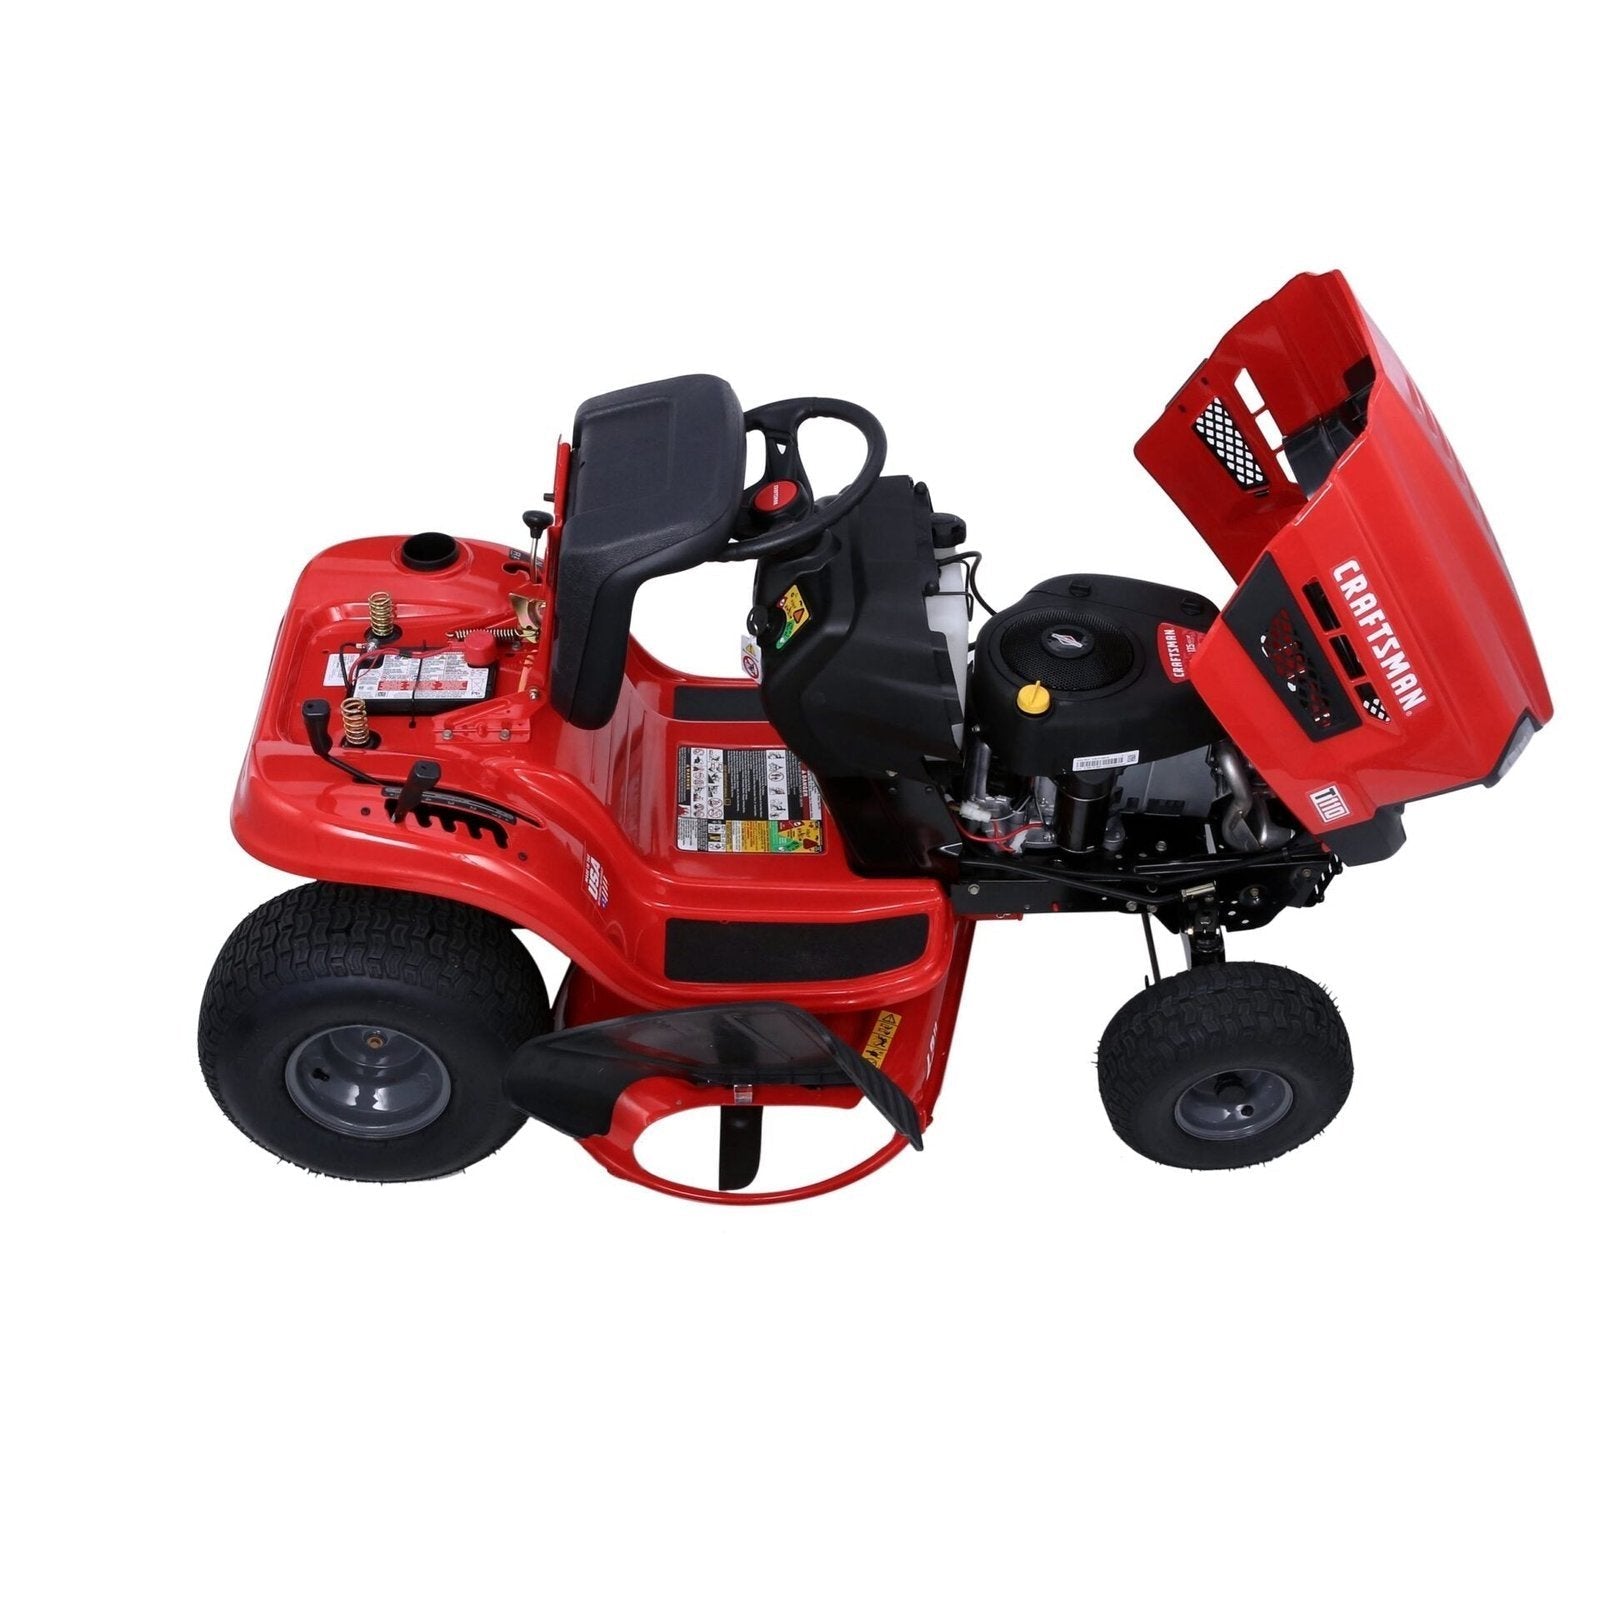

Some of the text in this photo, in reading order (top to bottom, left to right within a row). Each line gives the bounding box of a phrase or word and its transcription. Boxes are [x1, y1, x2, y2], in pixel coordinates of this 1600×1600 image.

[1163, 629, 1185, 678] CRAFTSMAN
[1332, 559, 1427, 712] CRAFTSMAN
[1314, 787, 1346, 820] T110
[588, 856, 601, 901] USA
